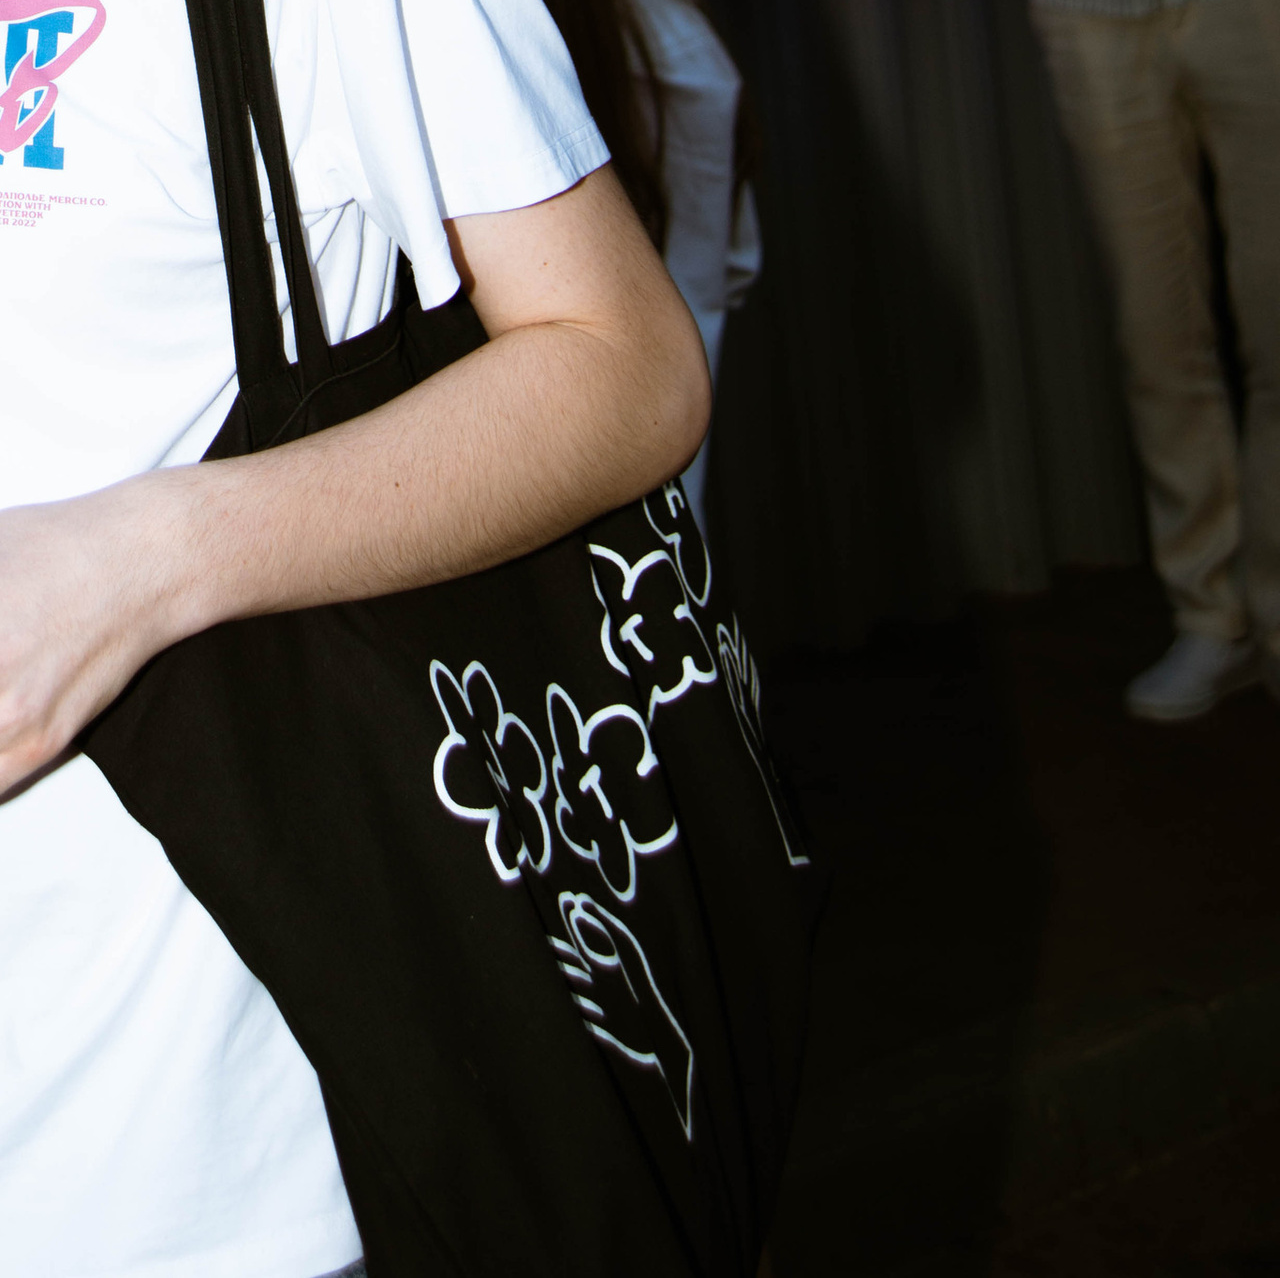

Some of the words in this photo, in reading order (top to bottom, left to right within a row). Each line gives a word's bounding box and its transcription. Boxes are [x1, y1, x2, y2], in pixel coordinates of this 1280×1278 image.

[48, 194, 88, 206] MERCH
[89, 197, 109, 207] CO.
[24, 201, 52, 212] WITH
[11, 218, 37, 228] 2022
